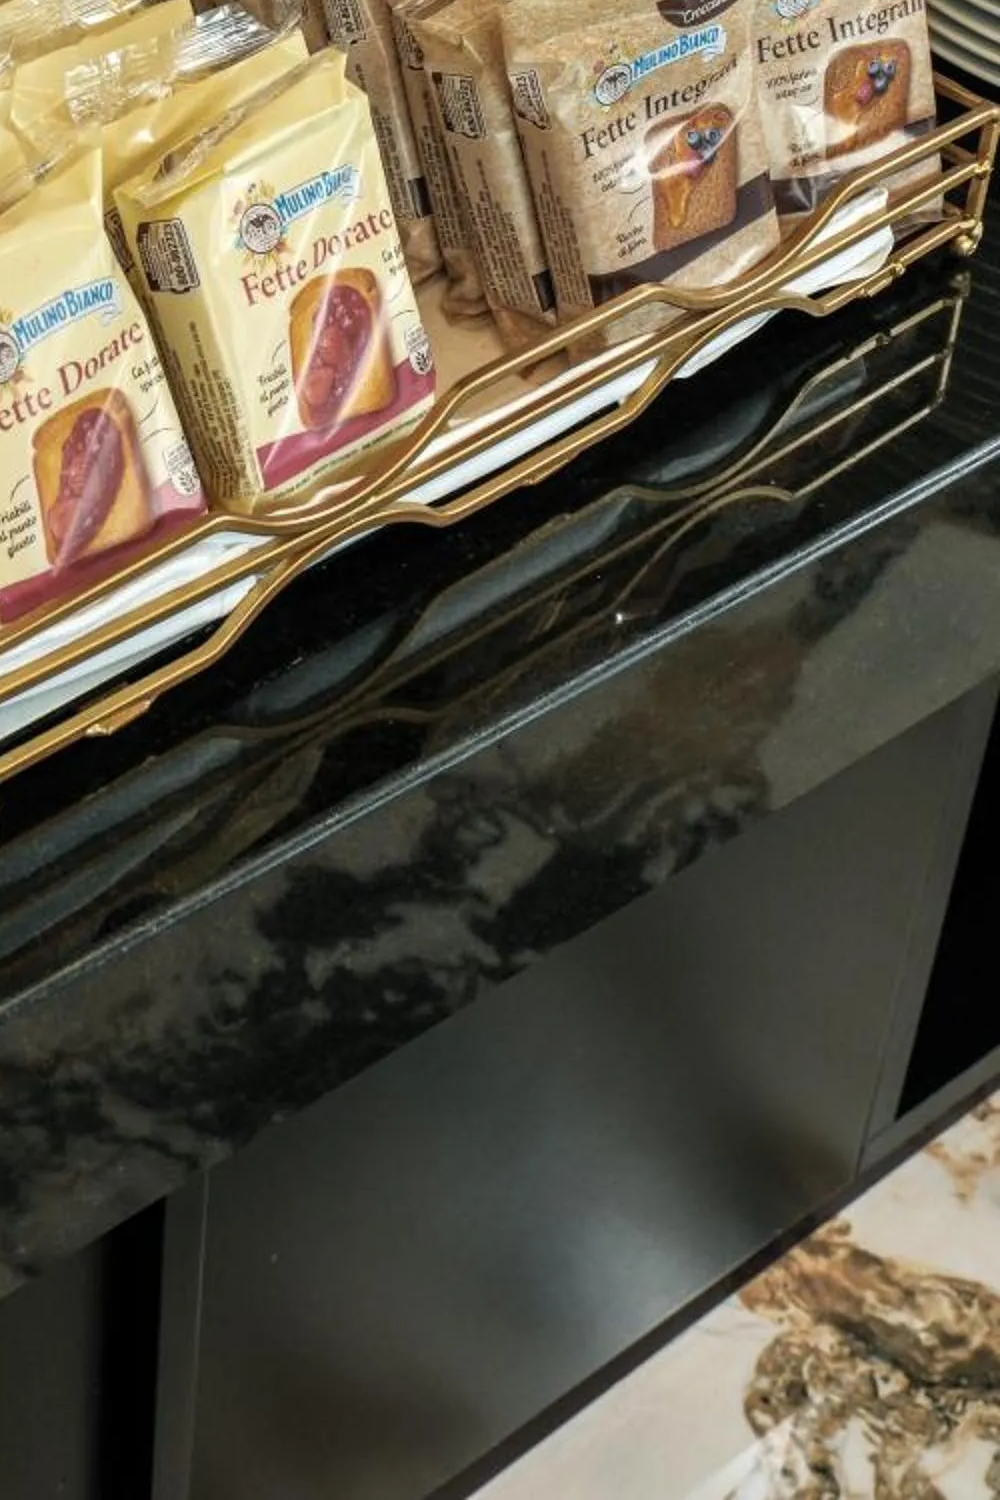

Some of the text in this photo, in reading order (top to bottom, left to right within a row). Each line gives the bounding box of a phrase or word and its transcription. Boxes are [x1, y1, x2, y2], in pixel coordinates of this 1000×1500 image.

[633, 27, 720, 77] MULINO BIANCO
[757, 29, 820, 64] Fette
[580, 110, 636, 159] Fette
[274, 183, 323, 222] MULINO
[240, 259, 308, 307] Fette
[312, 208, 394, 269] Dorate
[11, 281, 113, 350] MULINO BIANCO
[57, 321, 144, 396] Dorate
